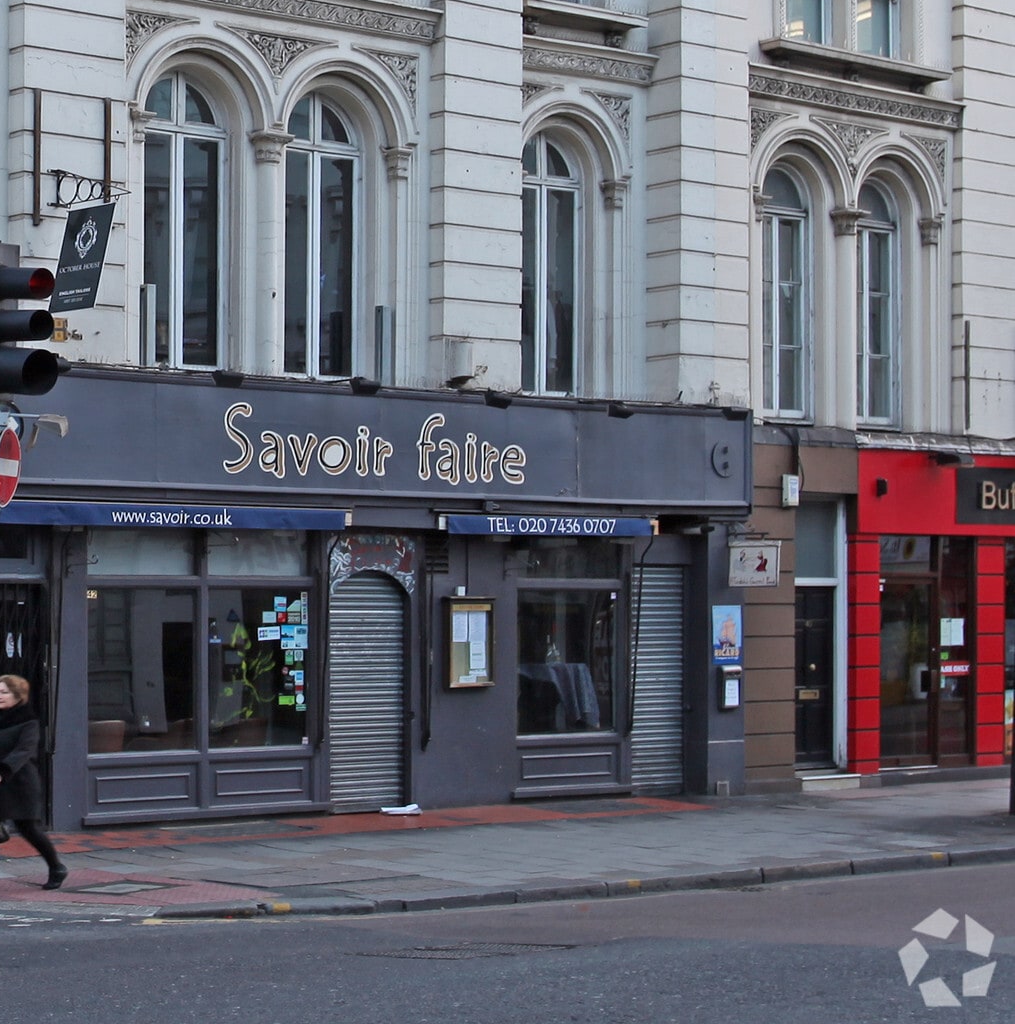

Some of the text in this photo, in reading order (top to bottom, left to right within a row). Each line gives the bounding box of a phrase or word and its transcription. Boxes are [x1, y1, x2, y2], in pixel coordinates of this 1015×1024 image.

[83, 261, 100, 270] HOUSE
[223, 402, 526, 485] Savoir faire
[111, 508, 233, 525] www.savoir.co.uk
[487, 517, 616, 534] TEL: 020 7436 0707
